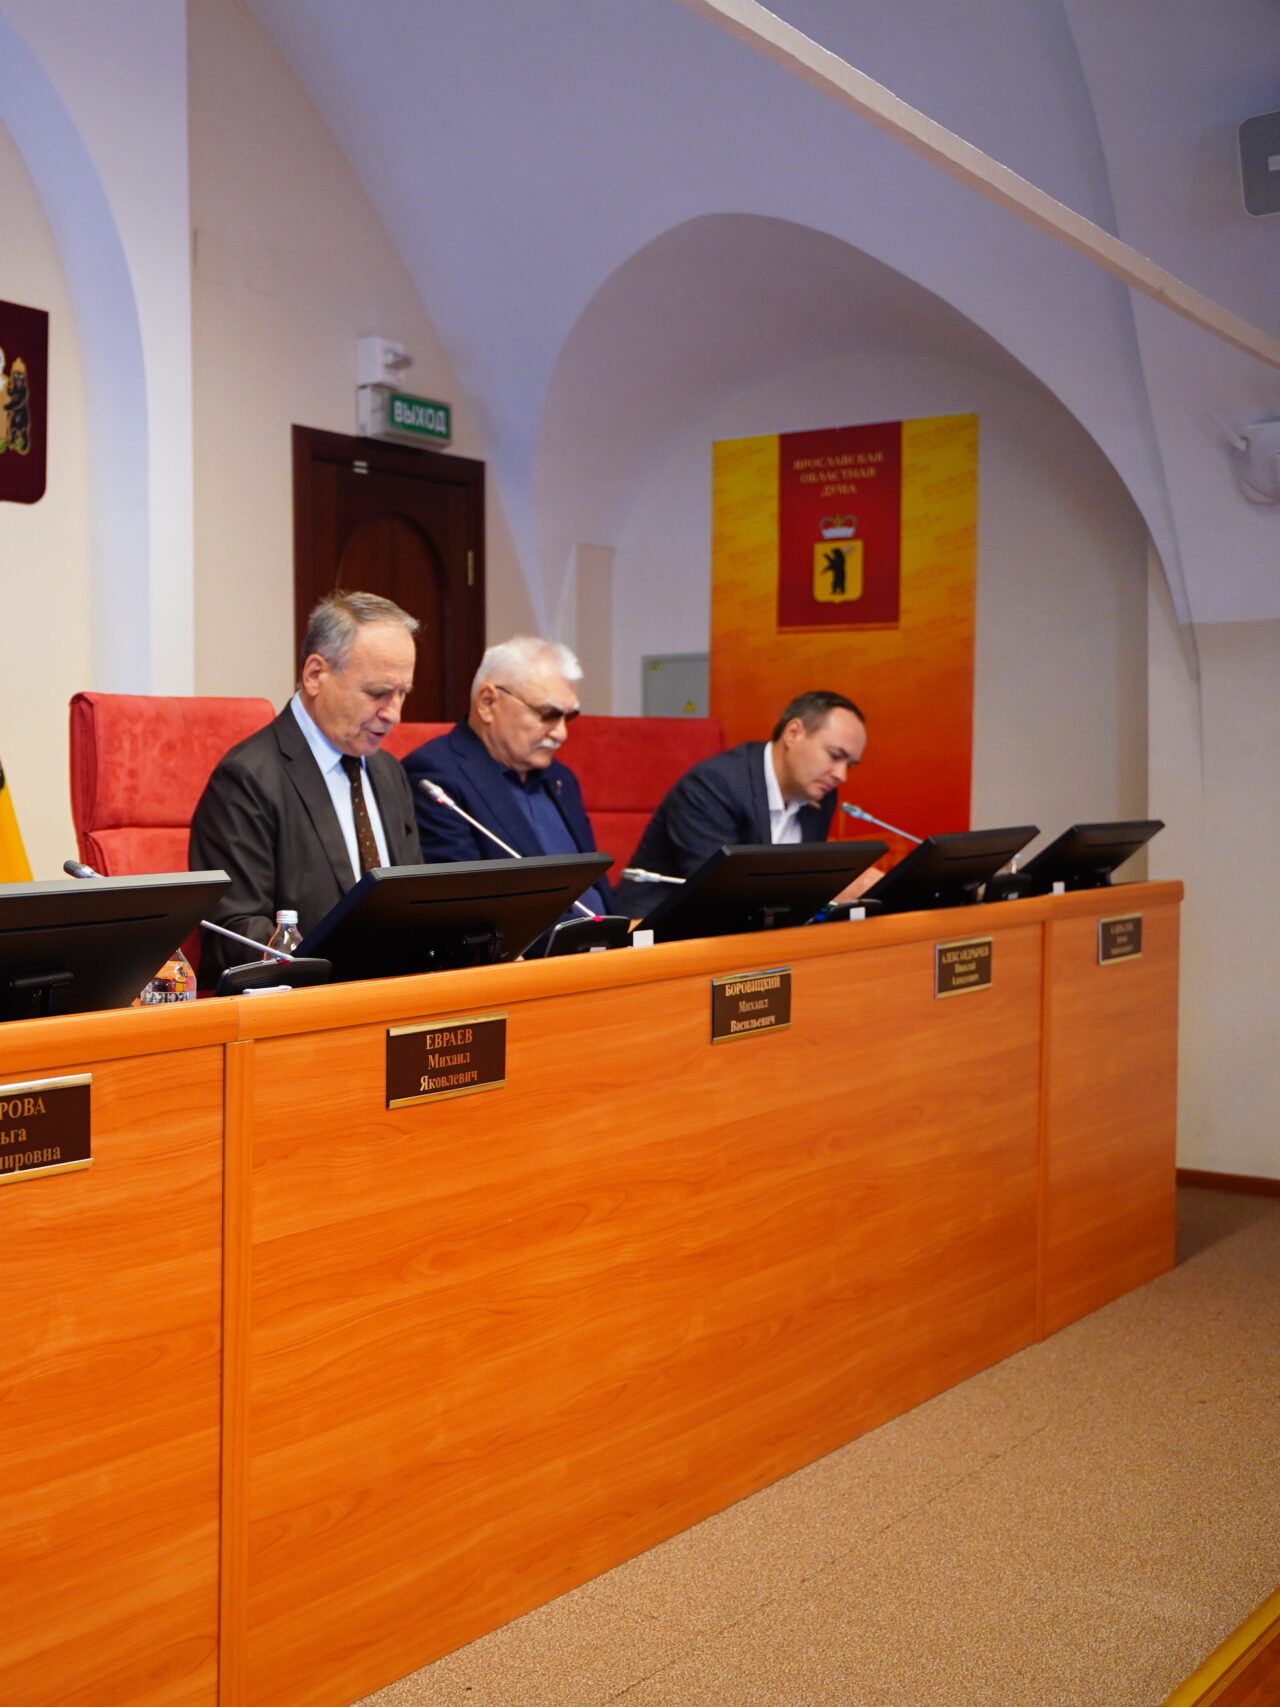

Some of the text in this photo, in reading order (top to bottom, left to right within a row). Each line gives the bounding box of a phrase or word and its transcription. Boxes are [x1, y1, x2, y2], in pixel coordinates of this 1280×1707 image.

[394, 400, 447, 434] ВЫХОД
[793, 451, 883, 470] ЯРОСЛАВСКАЯ
[800, 466, 876, 484] ОБЛАСТНАЯ
[820, 483, 857, 498] ДУМА
[725, 975, 780, 997] БОРОВИЦКИЙ
[738, 998, 769, 1013] Михаил
[730, 1015, 776, 1033] Васильевич
[425, 1028, 473, 1050] ЕВРАЕВ
[428, 1052, 471, 1070] Михаил
[420, 1070, 478, 1092] Яковлевич
